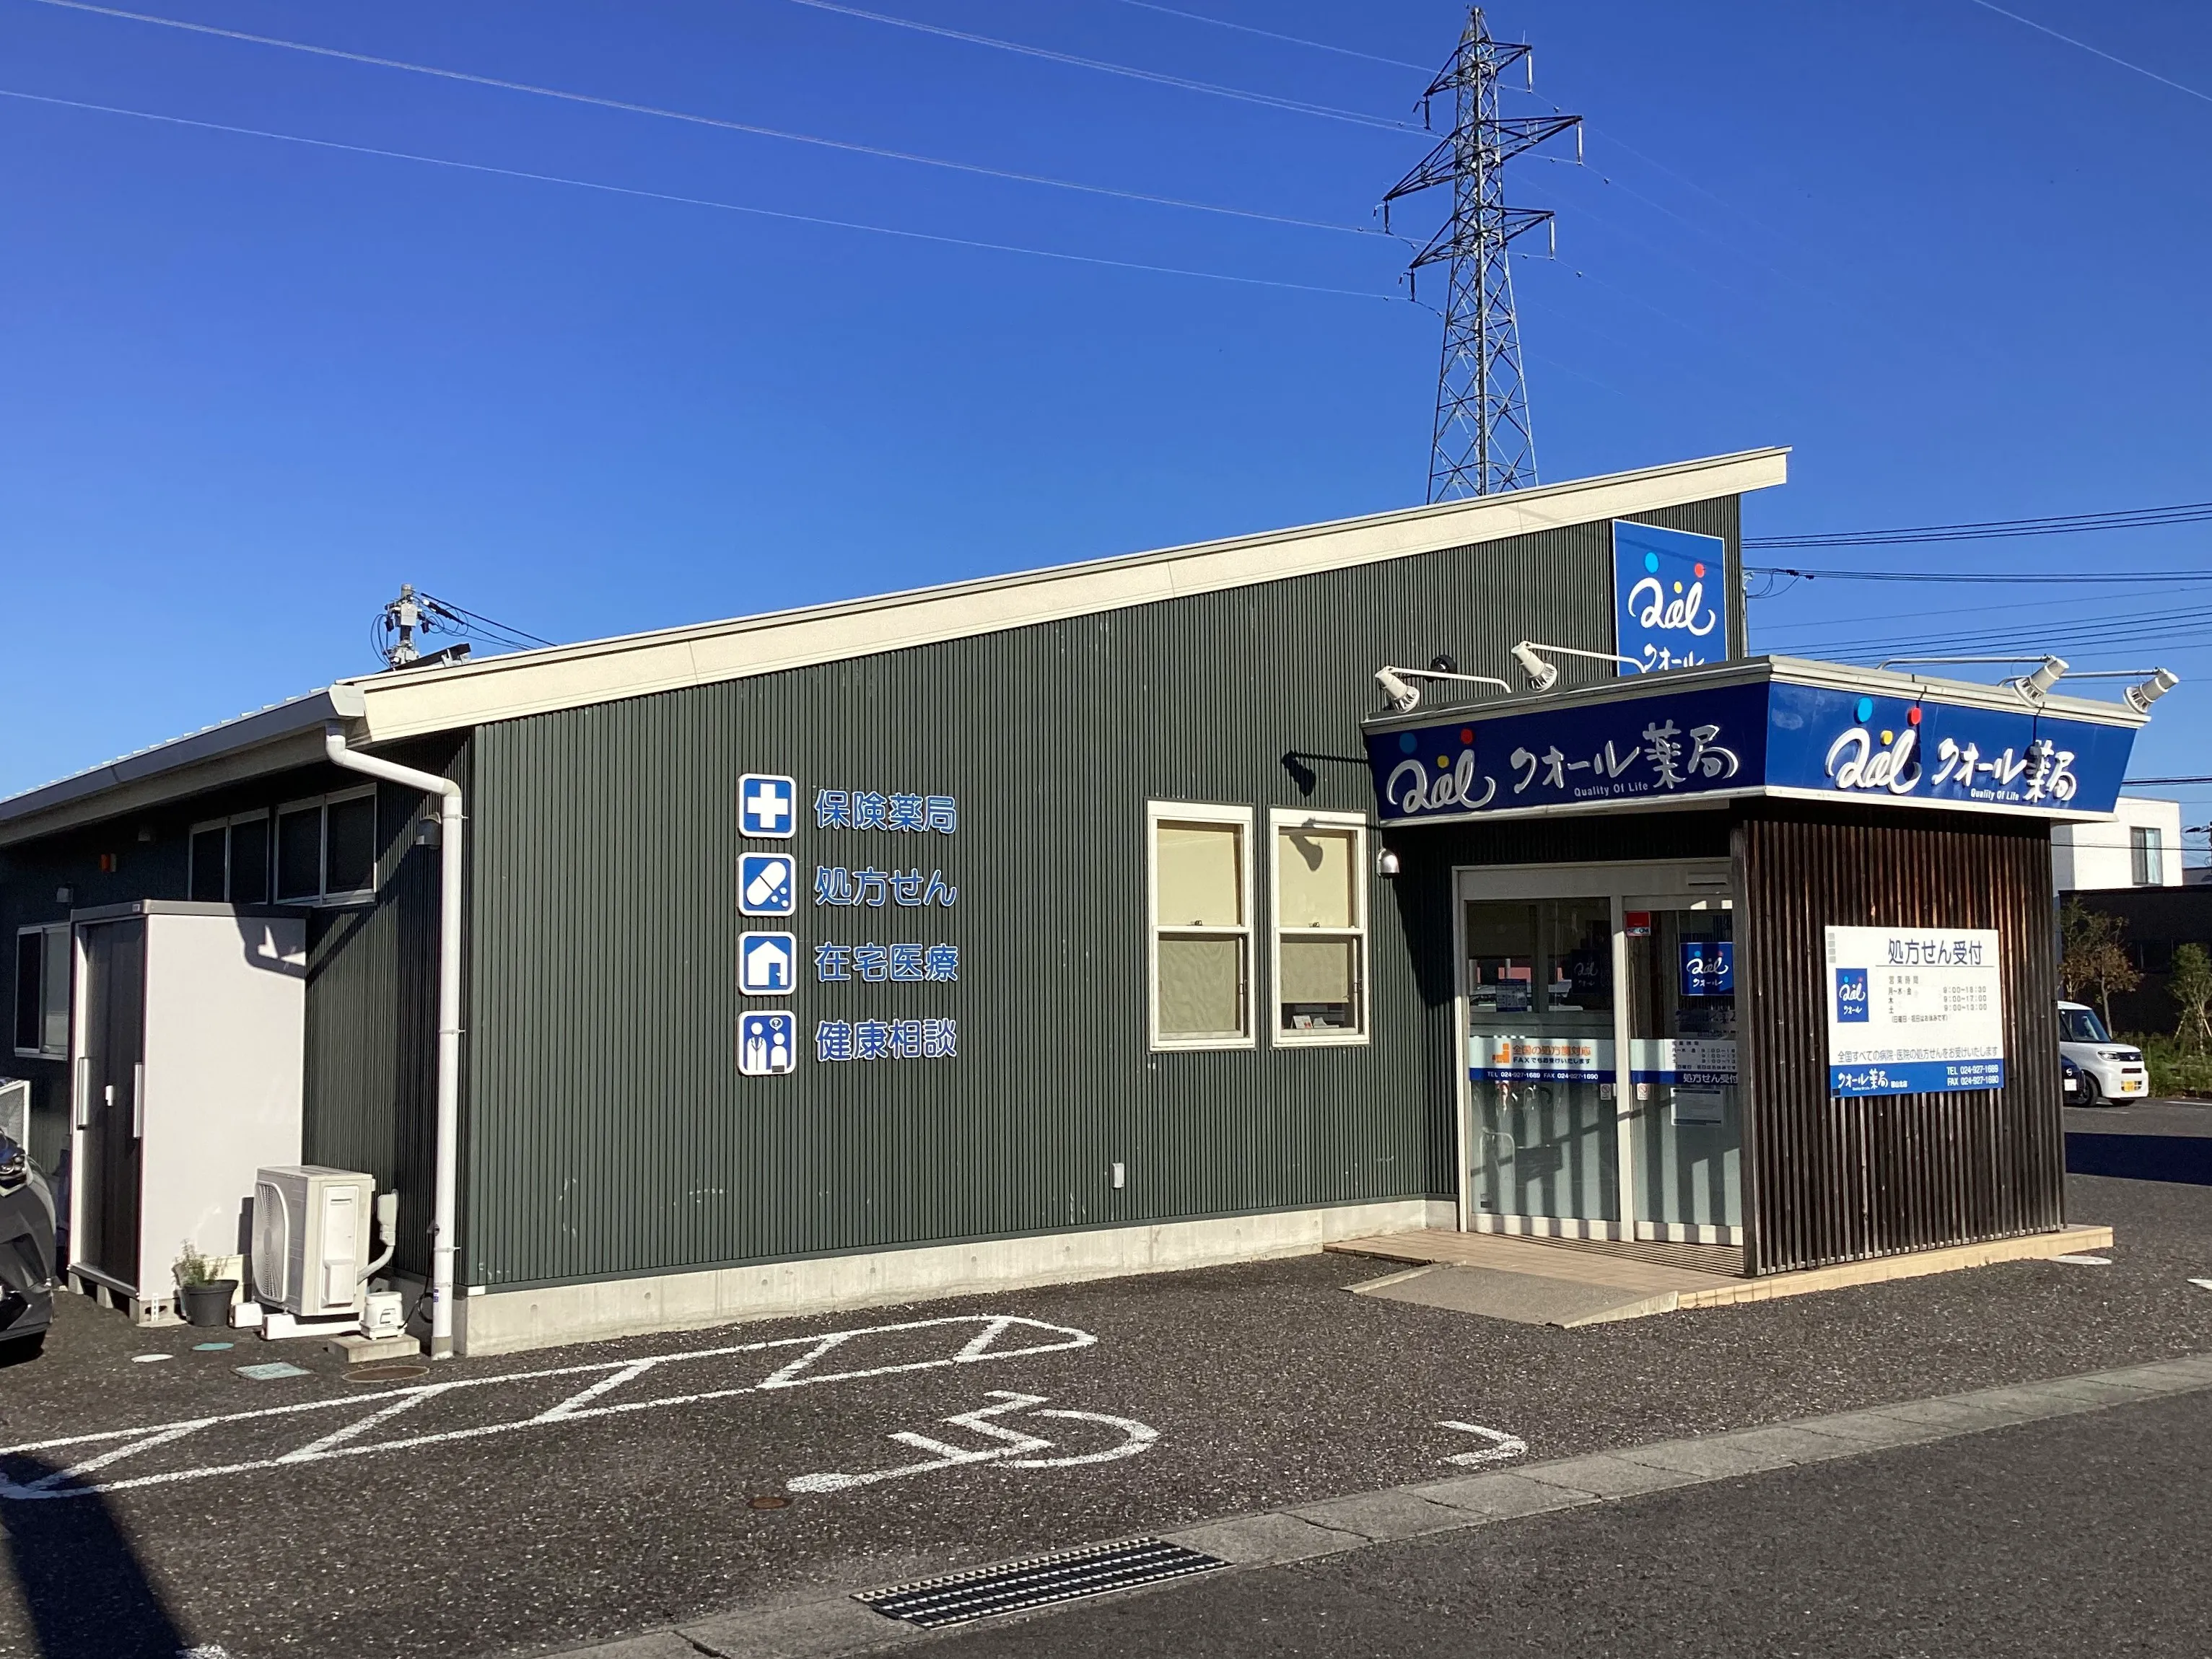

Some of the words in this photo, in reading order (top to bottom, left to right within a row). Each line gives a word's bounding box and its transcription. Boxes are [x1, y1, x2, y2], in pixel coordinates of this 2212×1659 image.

[1644, 642, 1705, 670] クオール
[1511, 719, 1739, 794] クオール薬局
[1931, 737, 2077, 802] クオール薬局
[1574, 785, 1609, 797] Quality
[1614, 783, 1625, 794] Of
[1629, 781, 1648, 792] Life
[1970, 787, 1995, 800] Quality
[1996, 789, 2005, 800] Of
[2006, 790, 2019, 801] Life
[815, 789, 957, 834] 保険薬局
[815, 866, 958, 907] 処方せん
[814, 940, 958, 982] 在宅医療
[1889, 939, 1982, 965] 処方せん受付
[1692, 978, 1723, 987] クオール
[1843, 1005, 1863, 1015] クオール
[815, 1017, 958, 1062] 健康相談
[1683, 1073, 1738, 1083] 処方せん受付
[1837, 1068, 1888, 1089] クオール薬局
[1946, 1067, 1958, 1075] TEL
[1947, 1077, 1959, 1086] FAX
